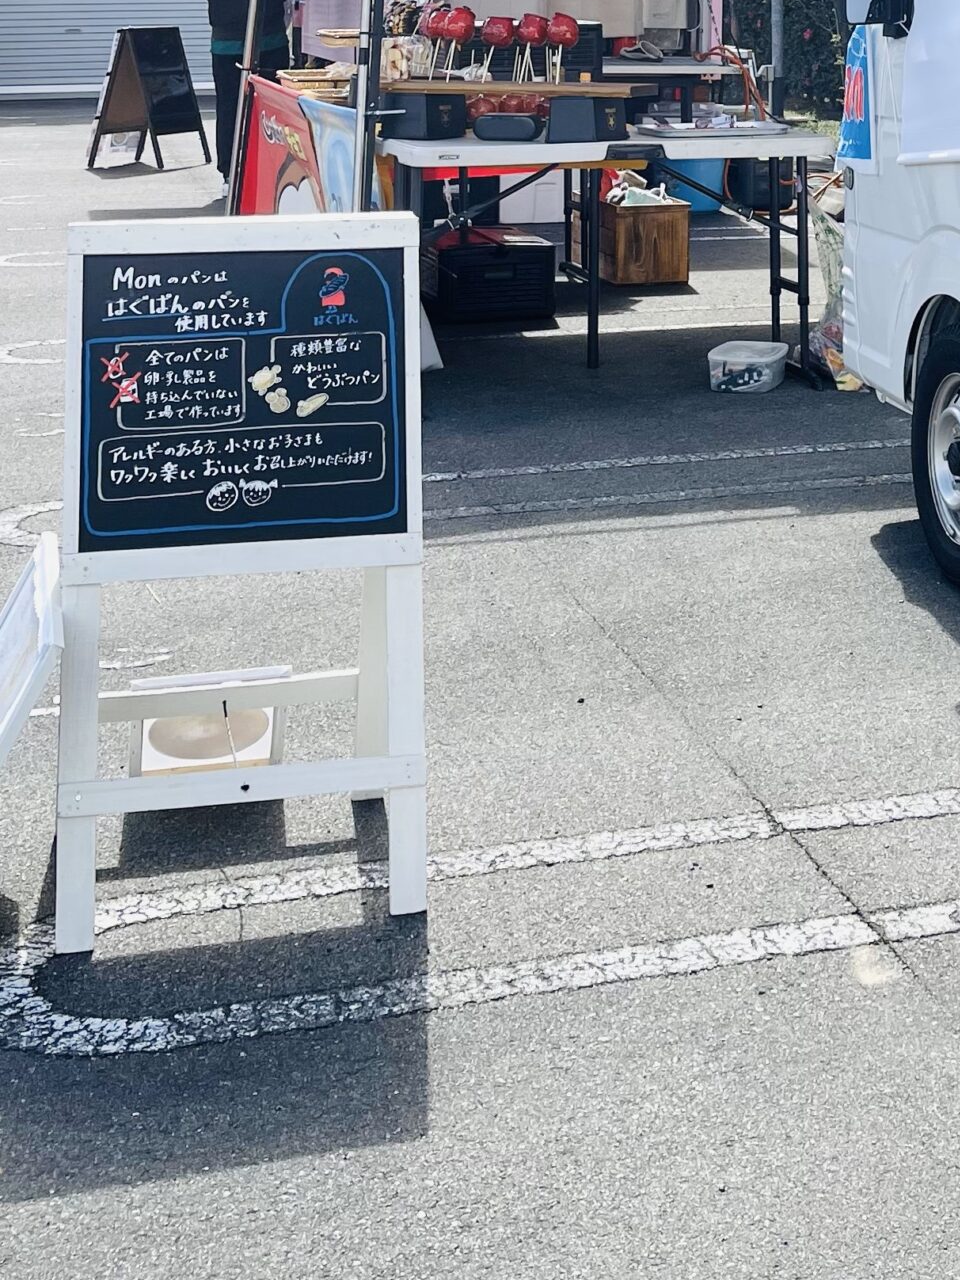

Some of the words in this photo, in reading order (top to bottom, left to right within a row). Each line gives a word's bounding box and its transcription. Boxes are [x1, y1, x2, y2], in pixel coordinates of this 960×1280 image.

[174, 309, 269, 333] 使用しています
[145, 347, 230, 366] 全てのパンは
[289, 338, 362, 358] 種類豊富な
[291, 362, 338, 375] かわいい
[306, 371, 382, 391] どうぶつパン
[144, 389, 239, 406] 持ち込んでいない
[144, 404, 242, 421] 工場で作っています
